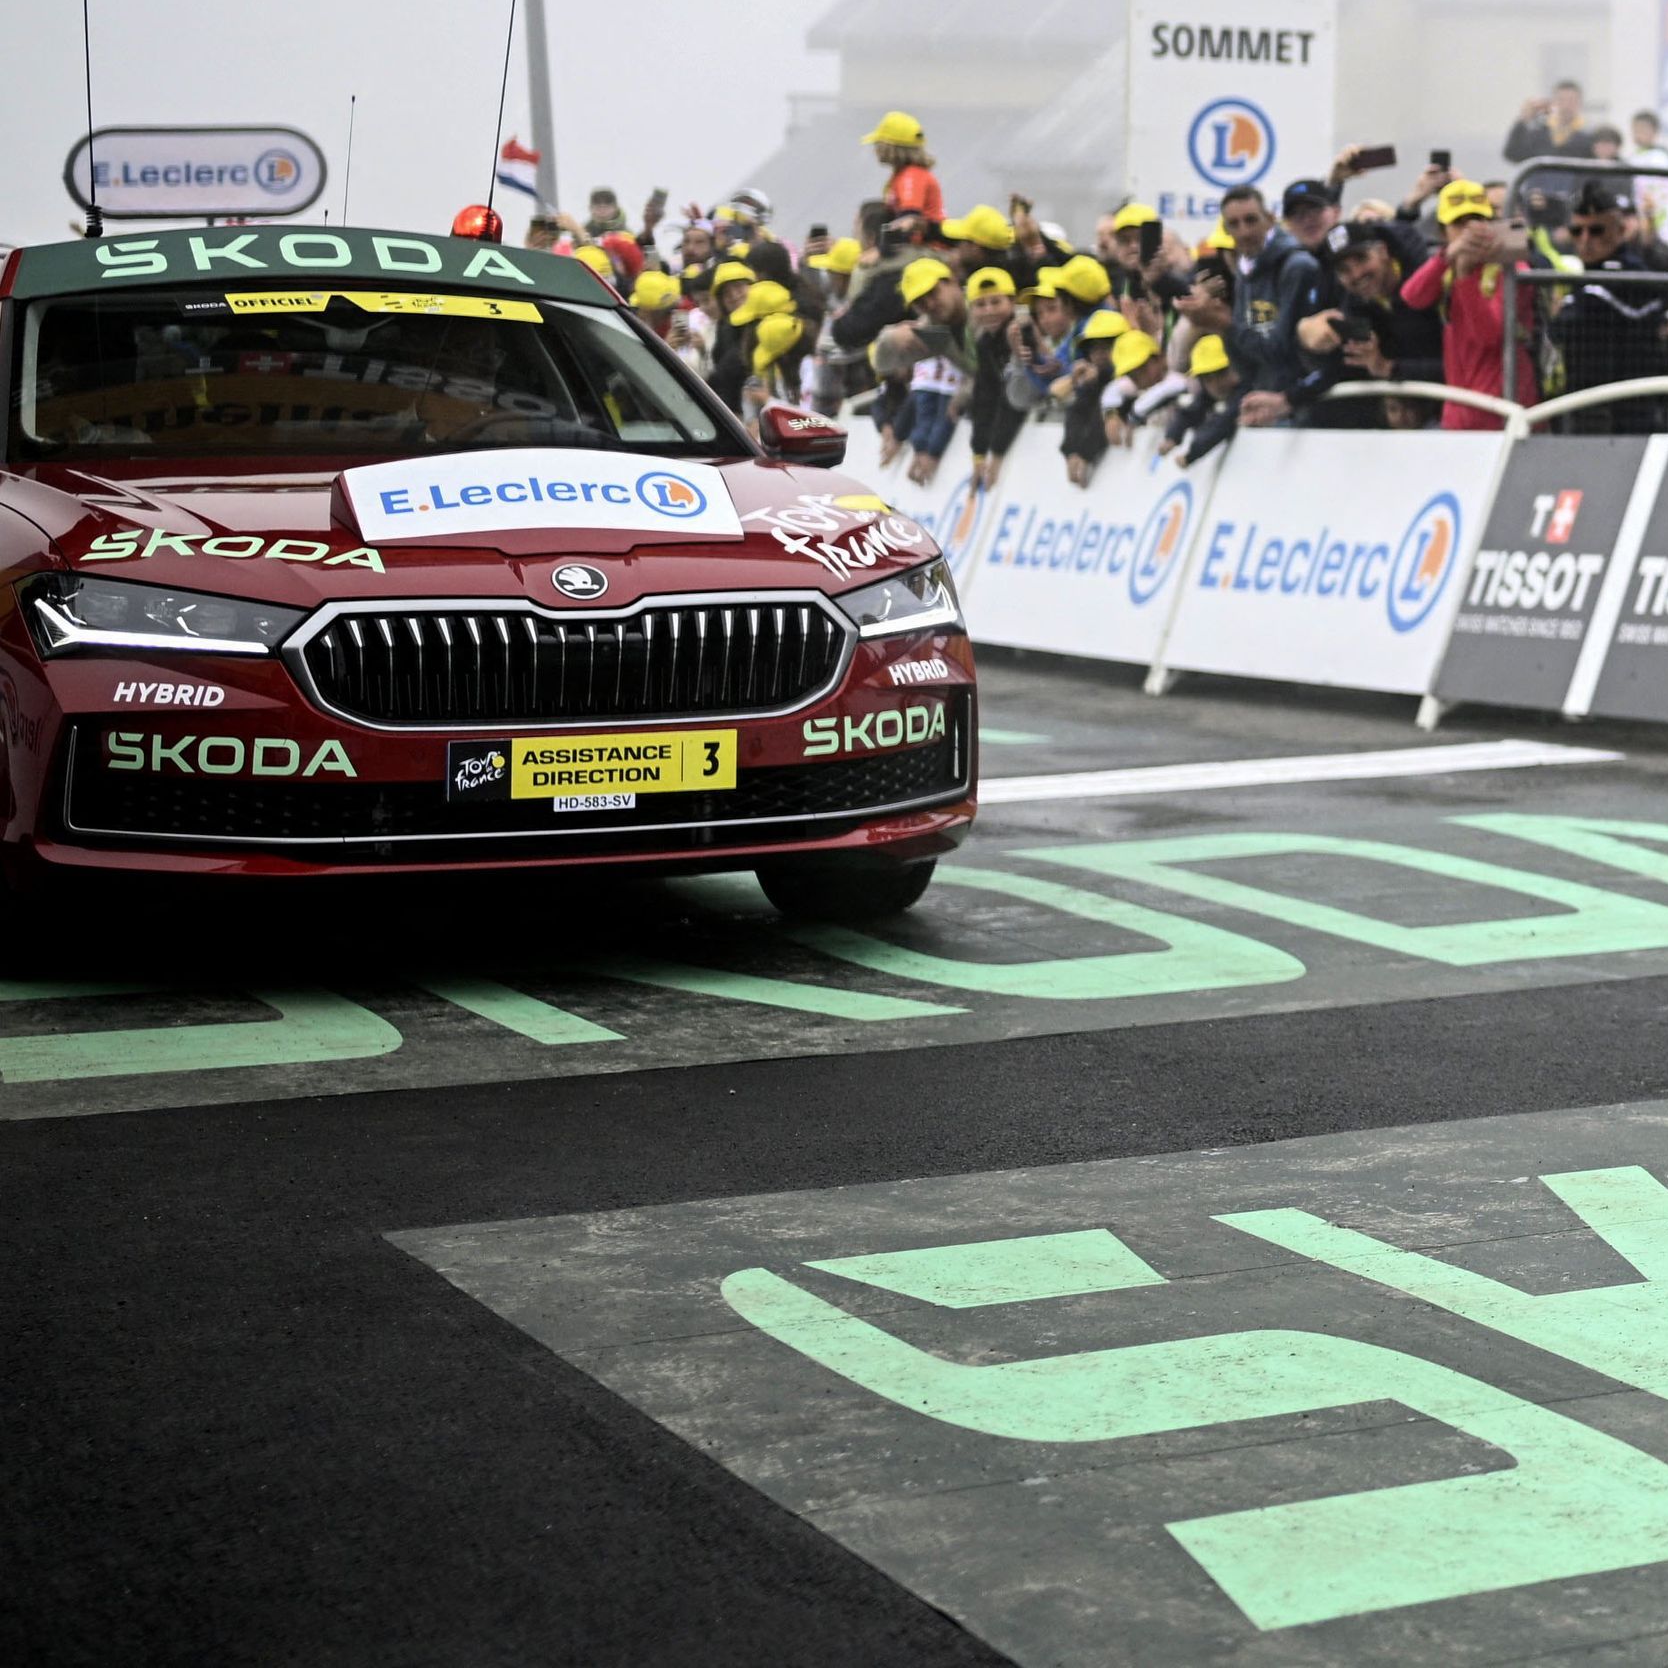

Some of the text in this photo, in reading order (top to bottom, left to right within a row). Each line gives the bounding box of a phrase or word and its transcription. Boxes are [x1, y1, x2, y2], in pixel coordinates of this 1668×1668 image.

[1152, 22, 1315, 66] SOMMET
[233, 297, 315, 308] OFFICIEL
[488, 303, 502, 315] 3
[380, 476, 631, 516] E.Leclerc
[987, 502, 1136, 576] E.Leclerc
[1199, 522, 1390, 600] E.Leclerc
[1469, 550, 1604, 612] TISSOT
[889, 659, 949, 687] HYBRID
[113, 681, 226, 709] HYBRID
[522, 741, 720, 777] ASSISTANCE 3
[532, 767, 660, 787] DIRECTION
[558, 796, 632, 810] HD-583-SV
